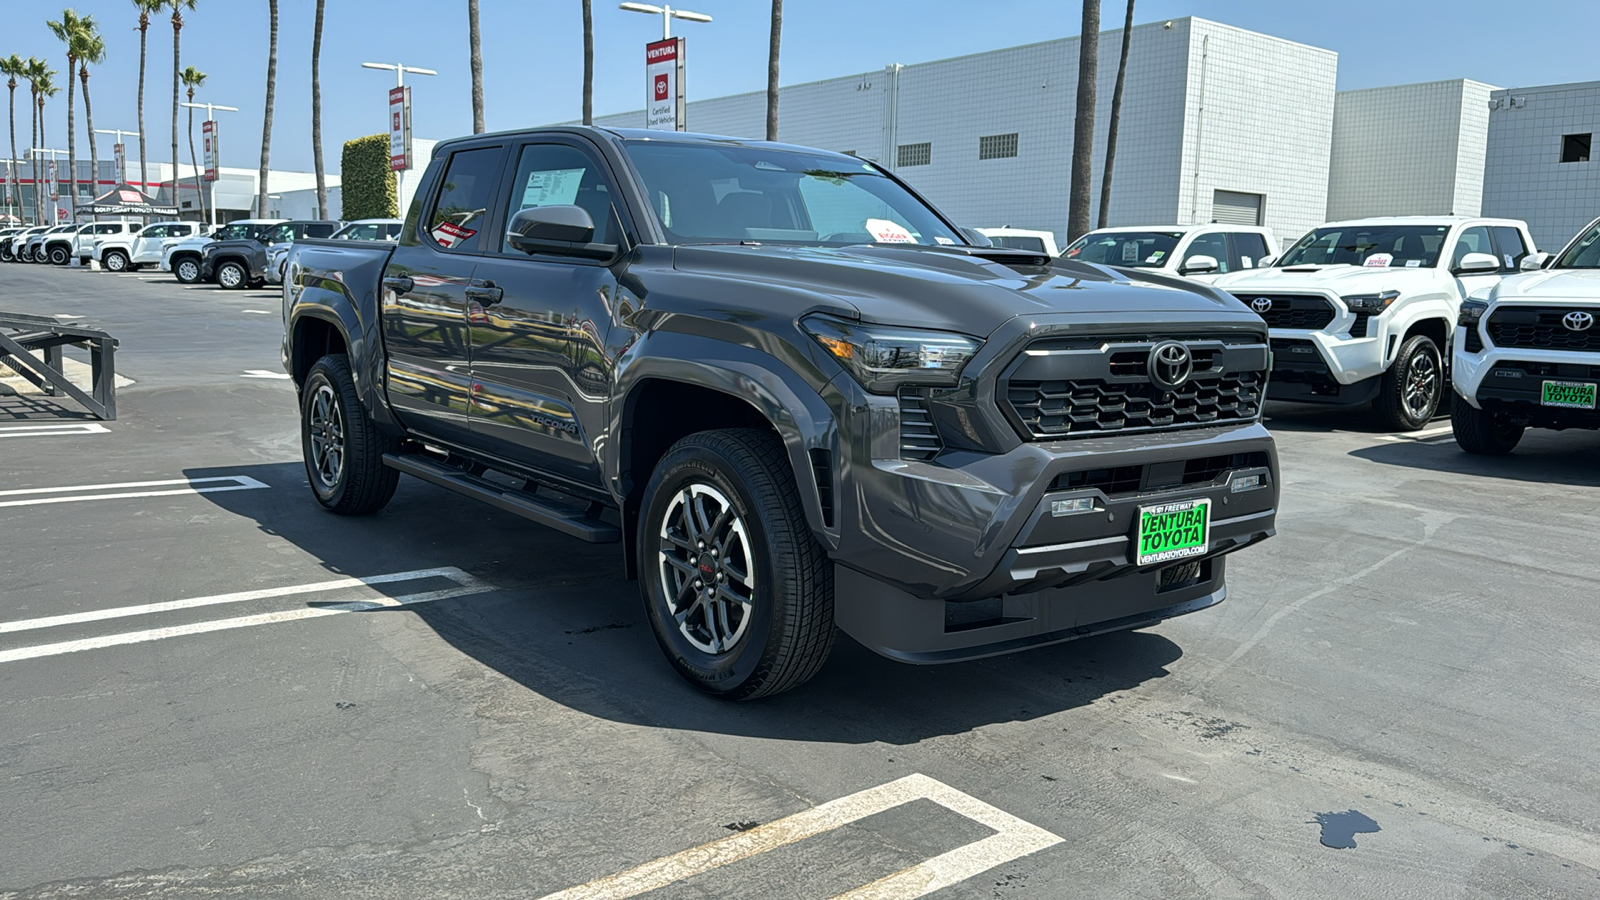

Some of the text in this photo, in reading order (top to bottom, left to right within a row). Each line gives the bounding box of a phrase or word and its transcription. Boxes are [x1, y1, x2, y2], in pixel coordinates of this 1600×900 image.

[648, 45, 675, 59] VENTURA
[652, 106, 671, 116] Certified
[648, 116, 675, 126] Used Vehicles
[1547, 385, 1593, 395] VENTURA
[1548, 393, 1592, 403] TOYOTA
[1543, 401, 1593, 409] VENTURATOYOTA.COM
[531, 414, 577, 434] TACOMA
[1164, 502, 1192, 512] FREEWAY
[1142, 510, 1202, 534] VENTURA
[1143, 527, 1200, 551] TOYOTA
[1140, 545, 1205, 564] VENTURATOYOTA.COM
